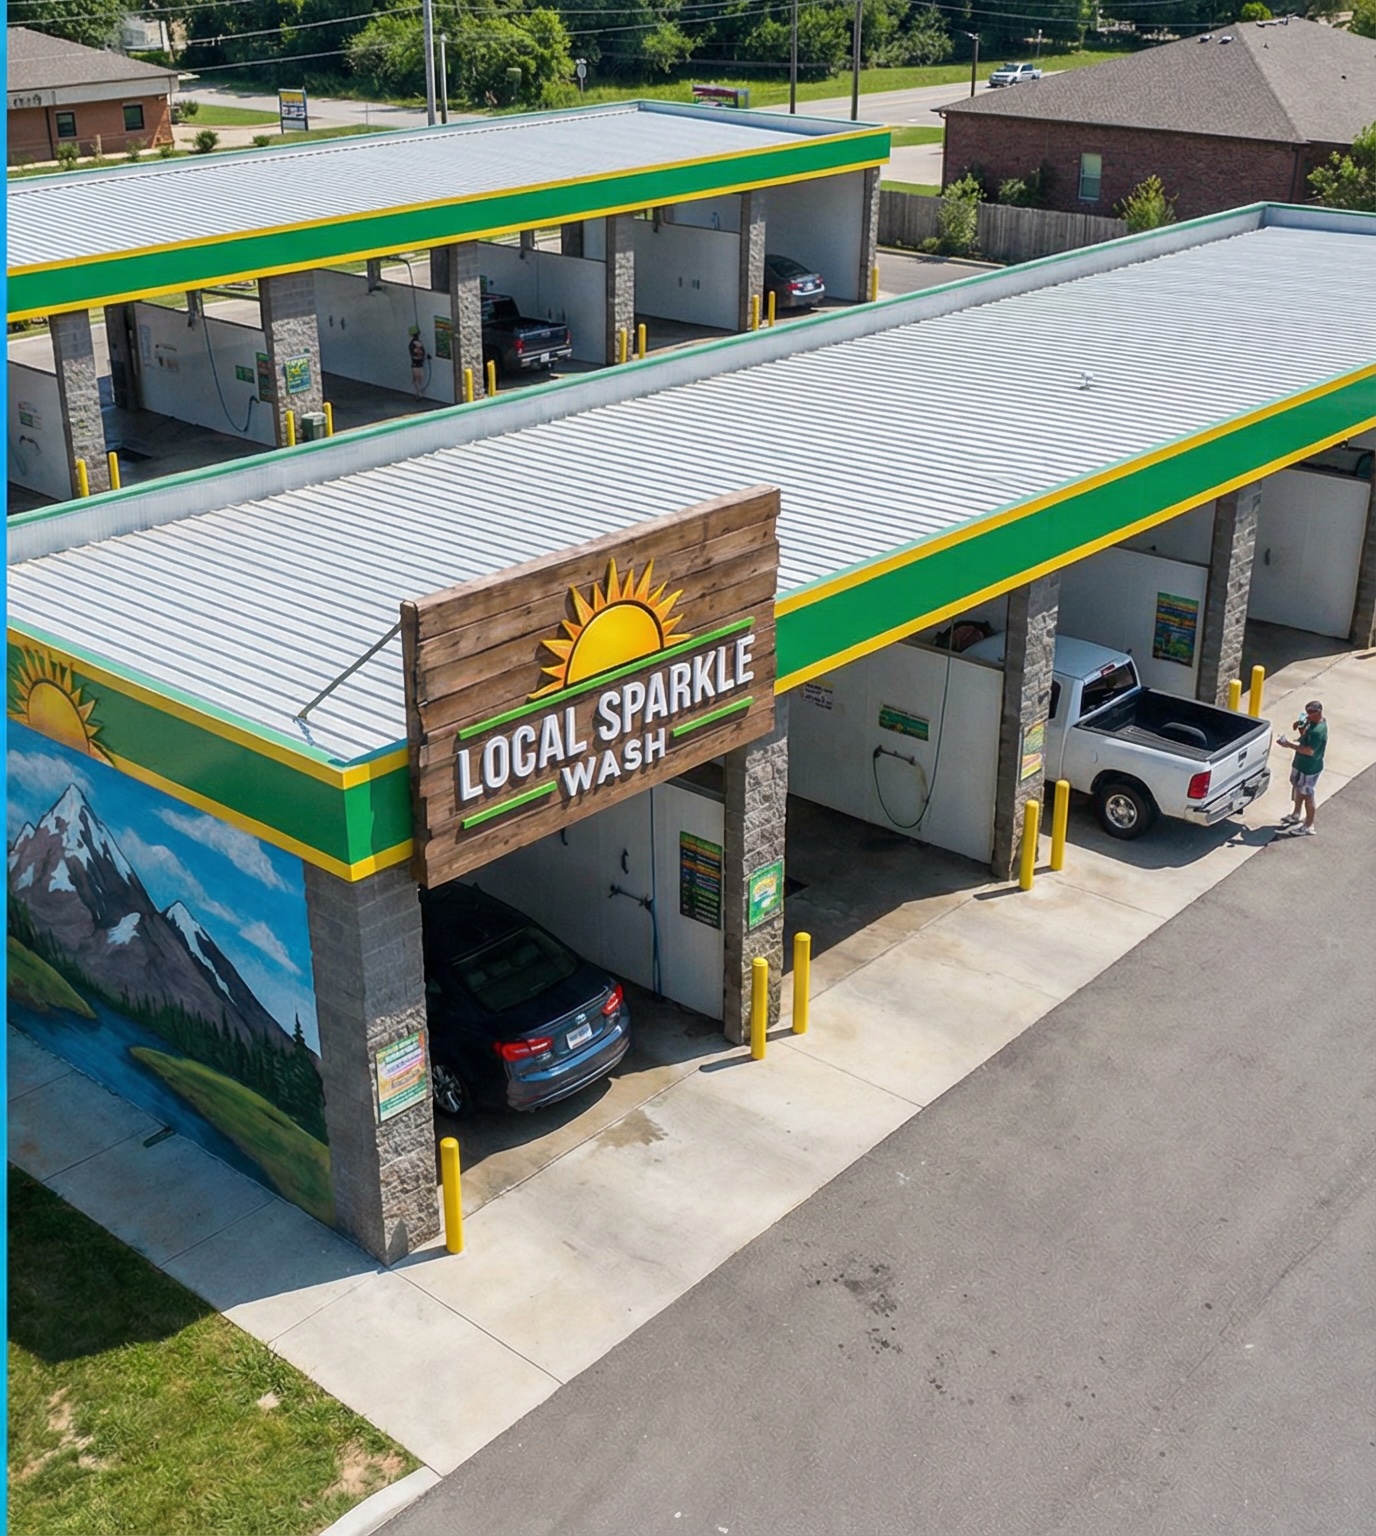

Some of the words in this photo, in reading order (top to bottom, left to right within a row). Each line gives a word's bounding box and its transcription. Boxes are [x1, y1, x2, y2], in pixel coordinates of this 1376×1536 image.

[457, 706, 587, 801] LOCAL
[598, 634, 756, 741] SPARKLE
[560, 727, 666, 797] WASH
